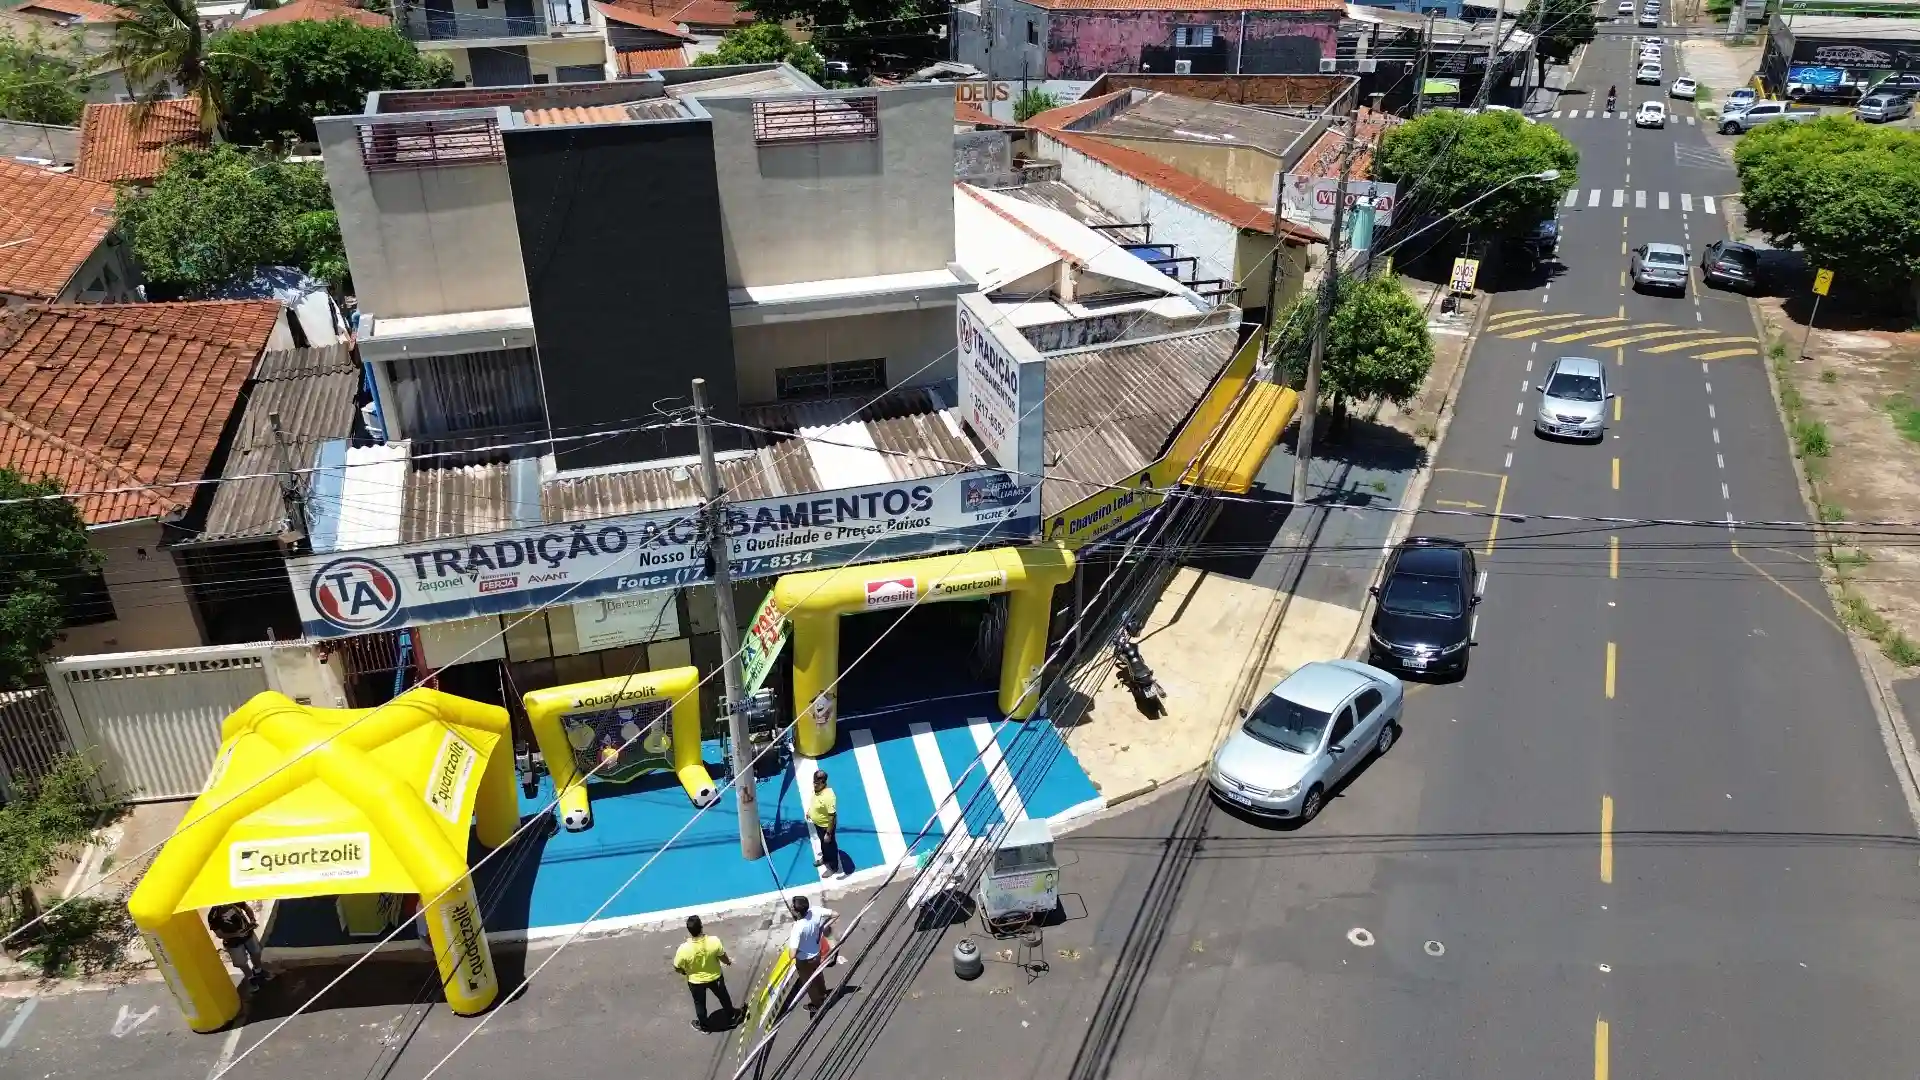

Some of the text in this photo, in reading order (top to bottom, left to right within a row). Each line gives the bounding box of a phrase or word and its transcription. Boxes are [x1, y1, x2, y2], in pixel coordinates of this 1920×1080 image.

[972, 326, 1018, 395] TRADIÇÃO
[974, 358, 1016, 413] ACABAMENTOS
[975, 510, 1004, 521] TIGRE
[1069, 503, 1112, 535] Chaveiro
[1113, 489, 1134, 512] Leka
[404, 523, 628, 580] TRADIÇÃO
[639, 552, 685, 567] Nosso
[746, 532, 820, 552] Qualidade
[824, 530, 833, 541] e
[837, 524, 882, 540] Preços
[887, 515, 931, 530] Baixos
[325, 572, 388, 616] TA
[416, 577, 464, 592] Zagonel
[528, 571, 570, 584] AVANT
[616, 574, 669, 591] Fone:
[945, 576, 1002, 595] quartzolit
[867, 590, 916, 605] brasilit
[584, 686, 656, 707] quartzolit
[437, 741, 465, 801] quartzolit
[260, 843, 361, 871] quartzolit
[451, 901, 485, 976] quartzolit
